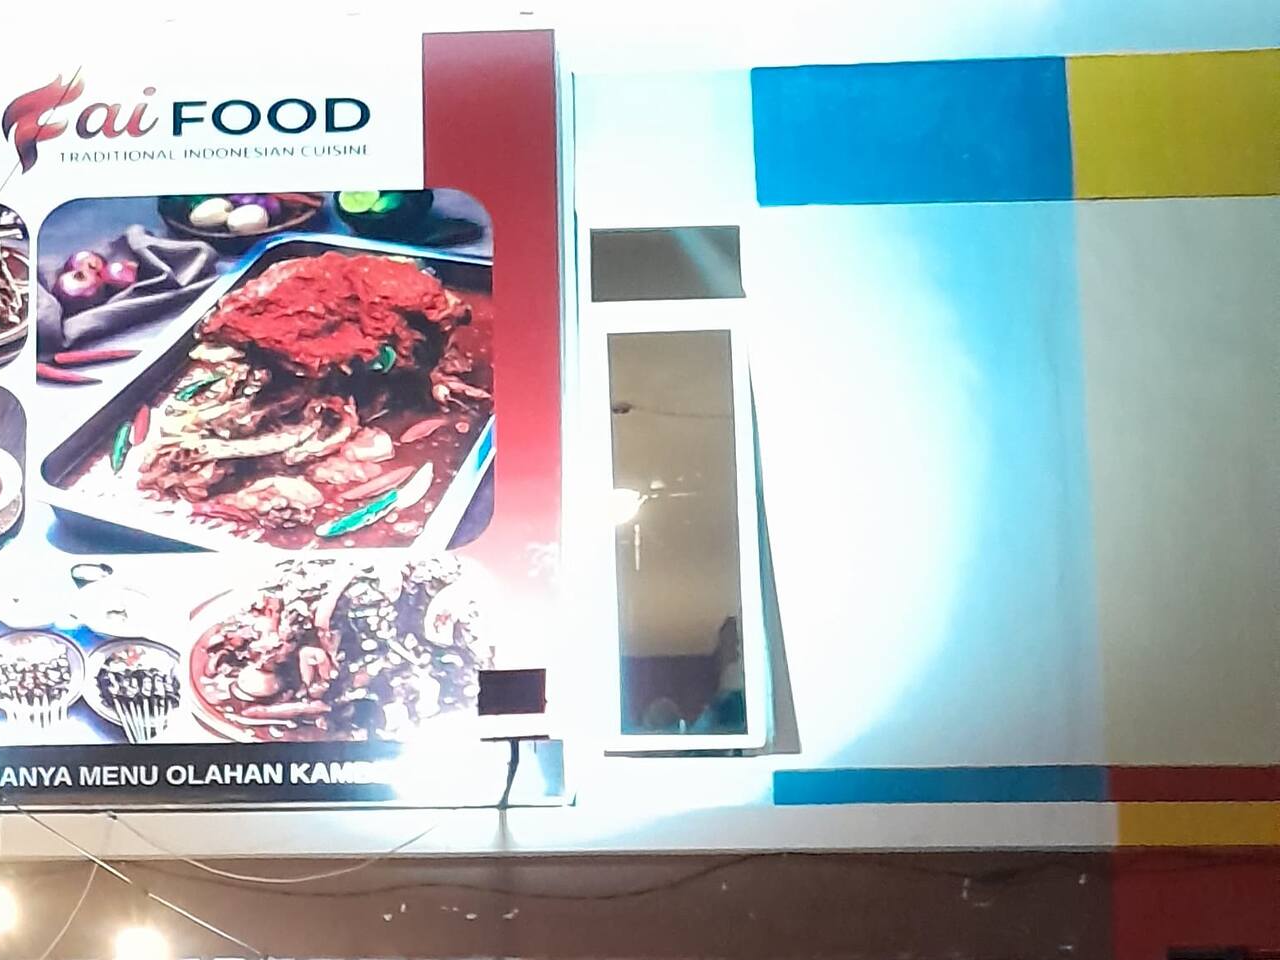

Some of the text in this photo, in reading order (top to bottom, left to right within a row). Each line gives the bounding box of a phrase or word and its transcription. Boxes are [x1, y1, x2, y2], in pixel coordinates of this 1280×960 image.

[172, 96, 372, 137] FOOD
[60, 144, 370, 163] TRADITIONAL INDONESIAN CUISINE
[79, 765, 159, 787] MENU
[166, 762, 284, 786] OLAHAN
